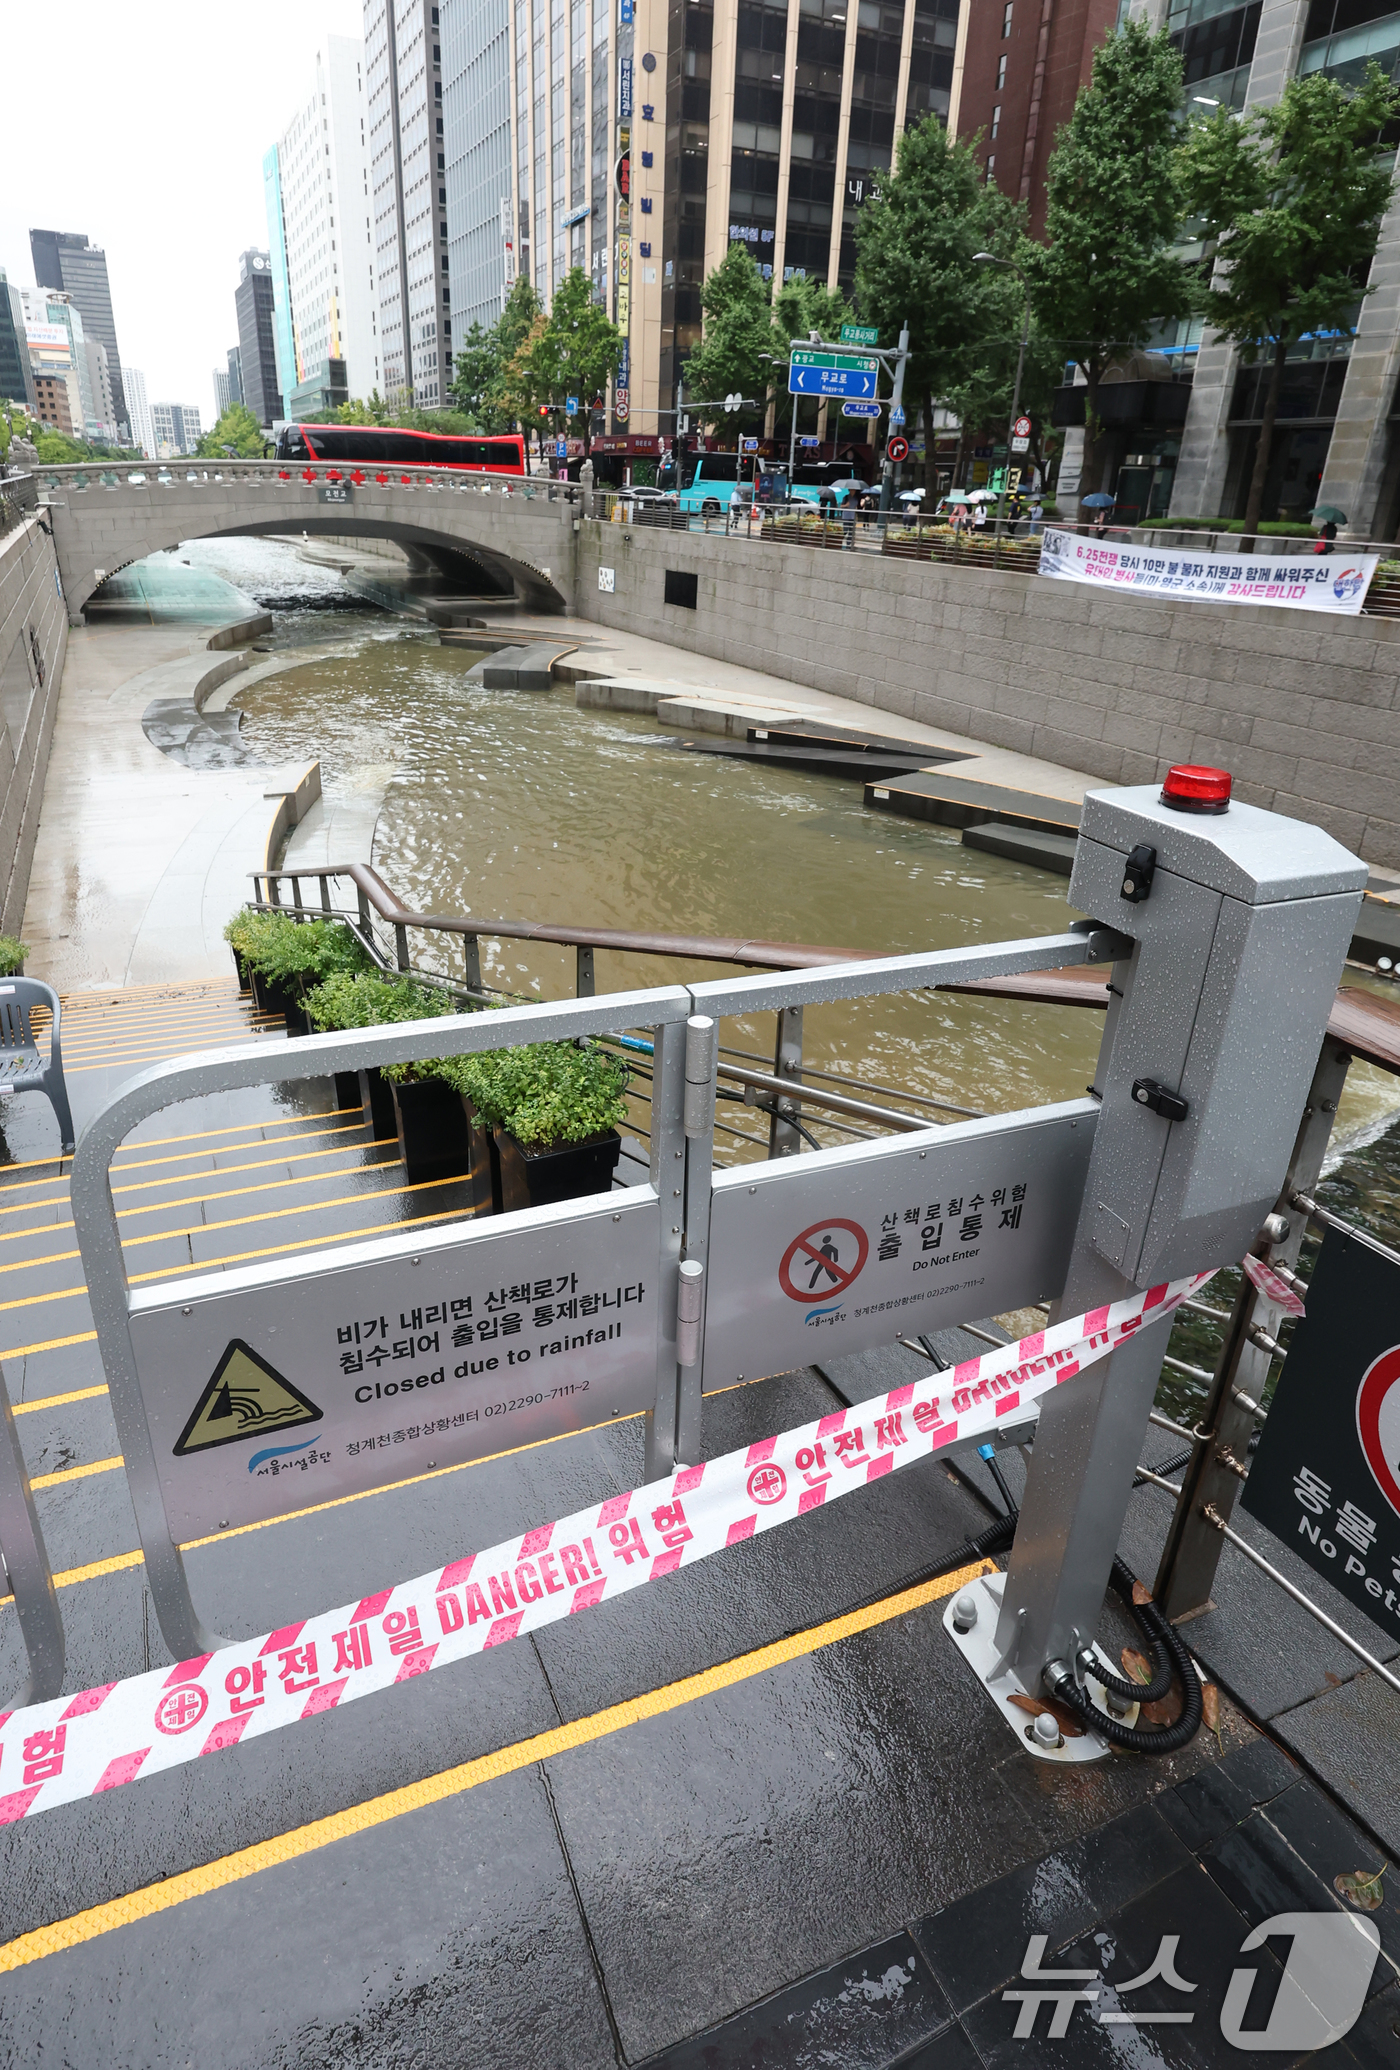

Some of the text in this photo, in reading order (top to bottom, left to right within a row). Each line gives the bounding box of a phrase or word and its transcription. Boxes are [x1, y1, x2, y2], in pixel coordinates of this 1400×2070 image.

[821, 371, 848, 384] 무교로
[857, 361, 869, 370] 시청
[635, 440, 652, 448] BEER
[1076, 546, 1118, 566] 6.25전쟁
[1120, 555, 1140, 568] 당시
[1143, 559, 1166, 574] 10만
[1181, 563, 1203, 578] 물자
[1206, 565, 1242, 581] 지원과
[1246, 567, 1270, 582] 함께
[1273, 568, 1330, 583] 싸워주신
[1084, 563, 1114, 580] 유대인
[1227, 582, 1306, 600] 감사드립니다
[877, 1205, 1022, 1262] 출입통제
[912, 1247, 980, 1272] Do Not Enter
[337, 1273, 579, 1347] 비가 내리면 산책로가
[808, 1311, 847, 1327] 서울시설공단
[853, 1292, 925, 1318] 청계천종합상황센터
[339, 1283, 645, 1376] 침수되어 출입을 통제합니다
[354, 1323, 622, 1404] Closed due to rainfall
[345, 1410, 479, 1457] 청계천종합상황센터
[795, 1396, 943, 1486] 안전제일
[257, 1450, 331, 1476] 서울시설공단
[1293, 1465, 1377, 1556] 동물
[1298, 1515, 1337, 1558] No
[225, 1497, 692, 1707] 안전제일 DANGER! 위험
[0, 1724, 67, 1785] 험
